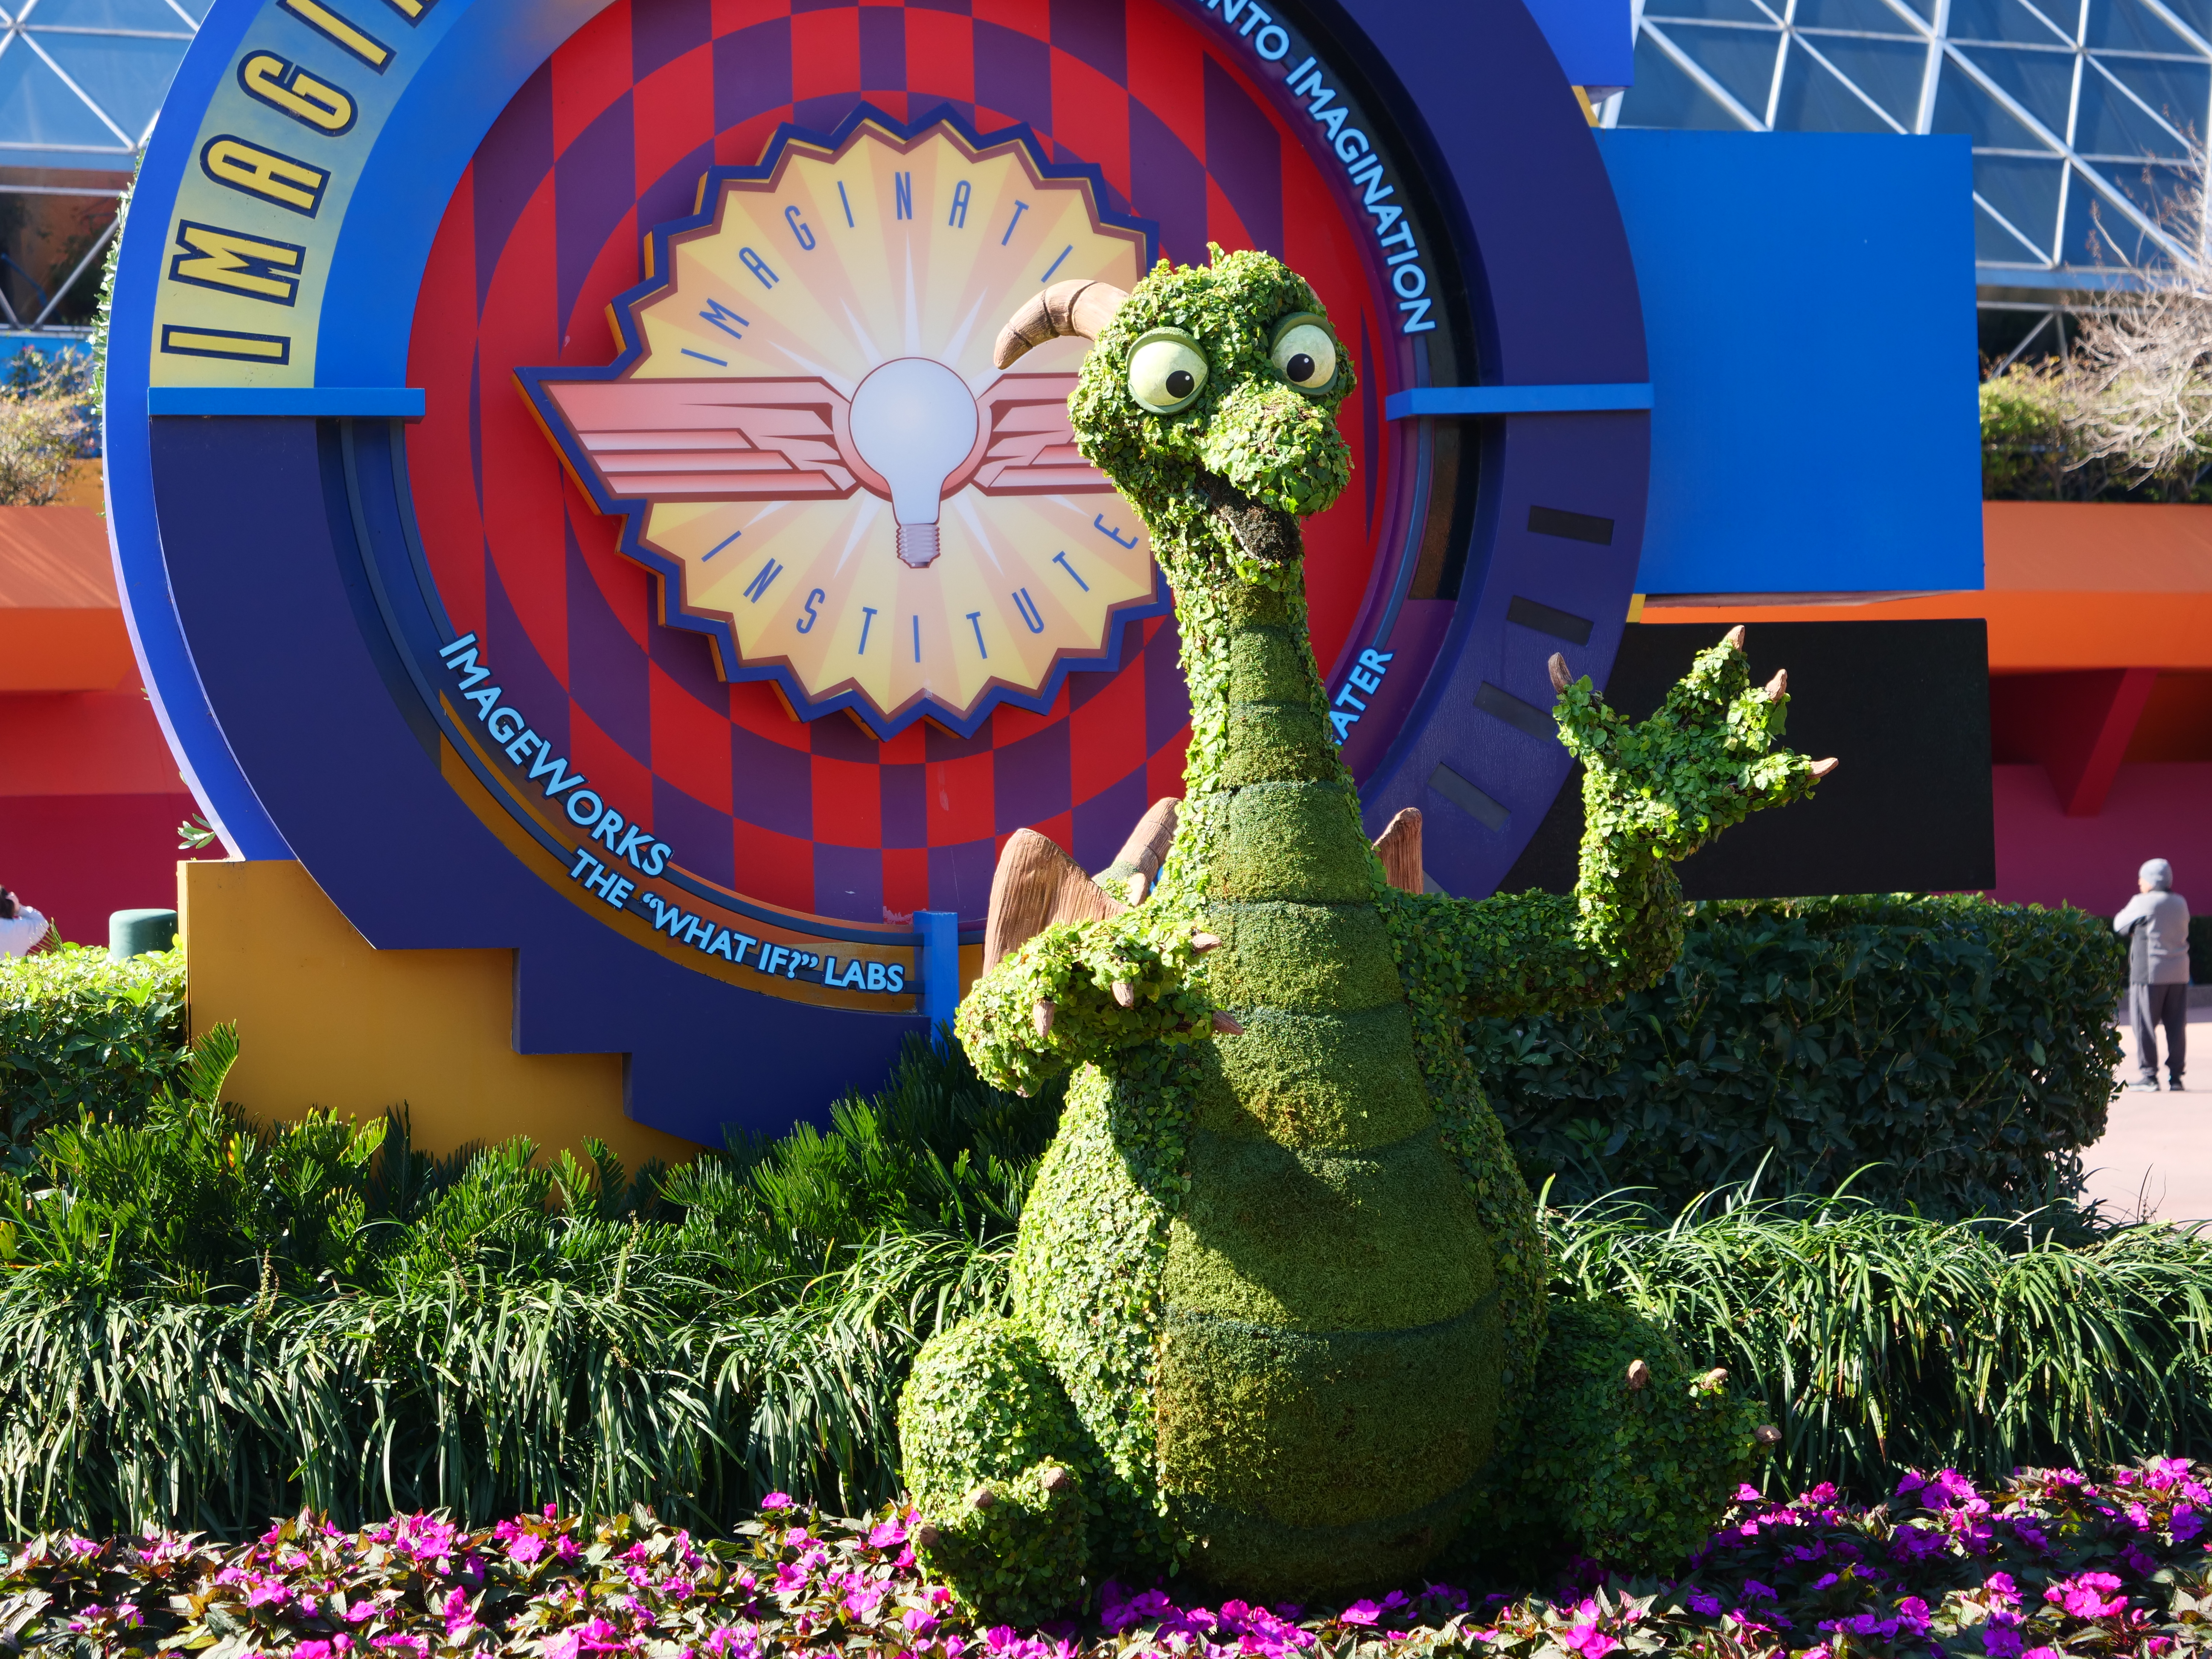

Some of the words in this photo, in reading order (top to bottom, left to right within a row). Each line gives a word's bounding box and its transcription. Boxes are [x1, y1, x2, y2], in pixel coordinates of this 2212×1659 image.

[160, 0, 439, 366] IMAGI
[1199, 0, 1289, 60] NTO
[1286, 56, 1435, 333] IMAGINATION
[681, 172, 1073, 367] IMAGINATI
[701, 513, 1139, 663] INSTITUTE
[439, 633, 672, 876] IMAGEWORKS
[1329, 649, 1393, 745] ATER
[570, 848, 635, 908] THE
[824, 957, 904, 992] LABS
